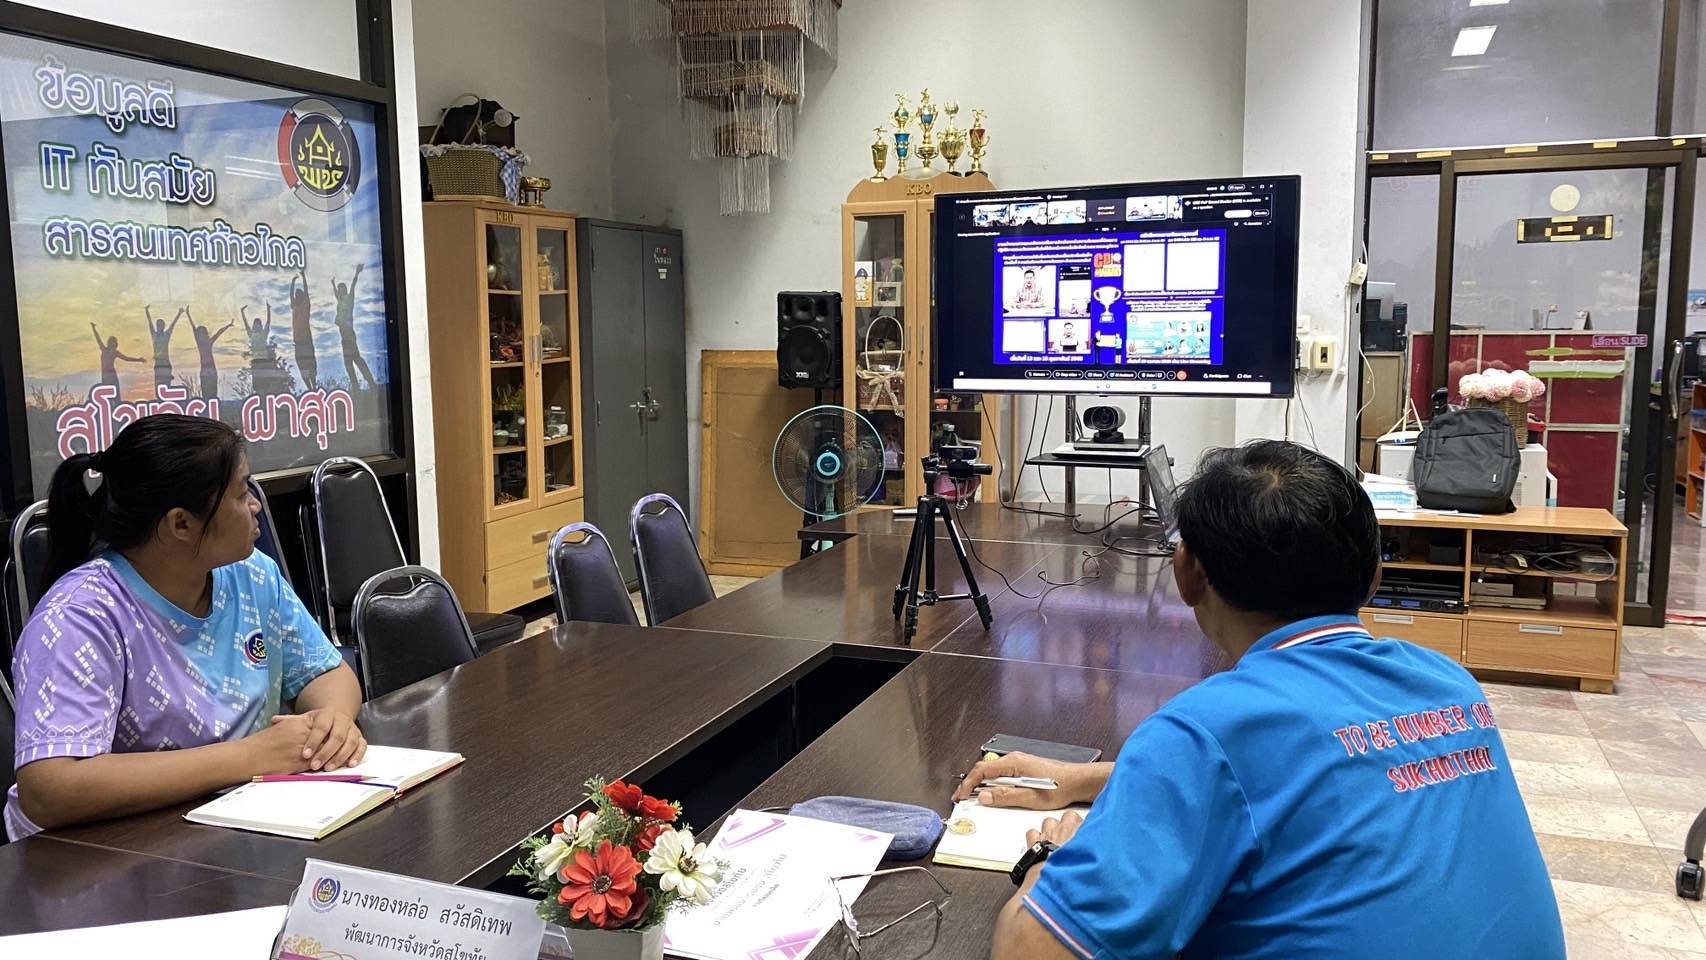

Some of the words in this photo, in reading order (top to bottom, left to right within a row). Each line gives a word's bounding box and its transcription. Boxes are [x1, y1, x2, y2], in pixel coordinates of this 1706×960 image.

[35, 55, 176, 133] ข้อมูลดี
[42, 143, 76, 190] IT
[88, 144, 215, 206] ทันสมัย
[905, 183, 932, 195] KBO
[45, 217, 306, 268] สารสนเทศก้าวไกล
[1621, 336, 1646, 345] SLIDE
[241, 388, 355, 450] ผาสุก
[1334, 725, 1369, 757] TO
[1366, 720, 1397, 750] BE
[1392, 704, 1472, 743] NUMBER
[1387, 745, 1497, 793] SUKHOTHAI
[341, 889, 429, 920] นางทองหล่อ
[439, 903, 513, 936] สวัสดิเทพ
[344, 922, 487, 960] พัฒนาการจังหวัดสโขทั
